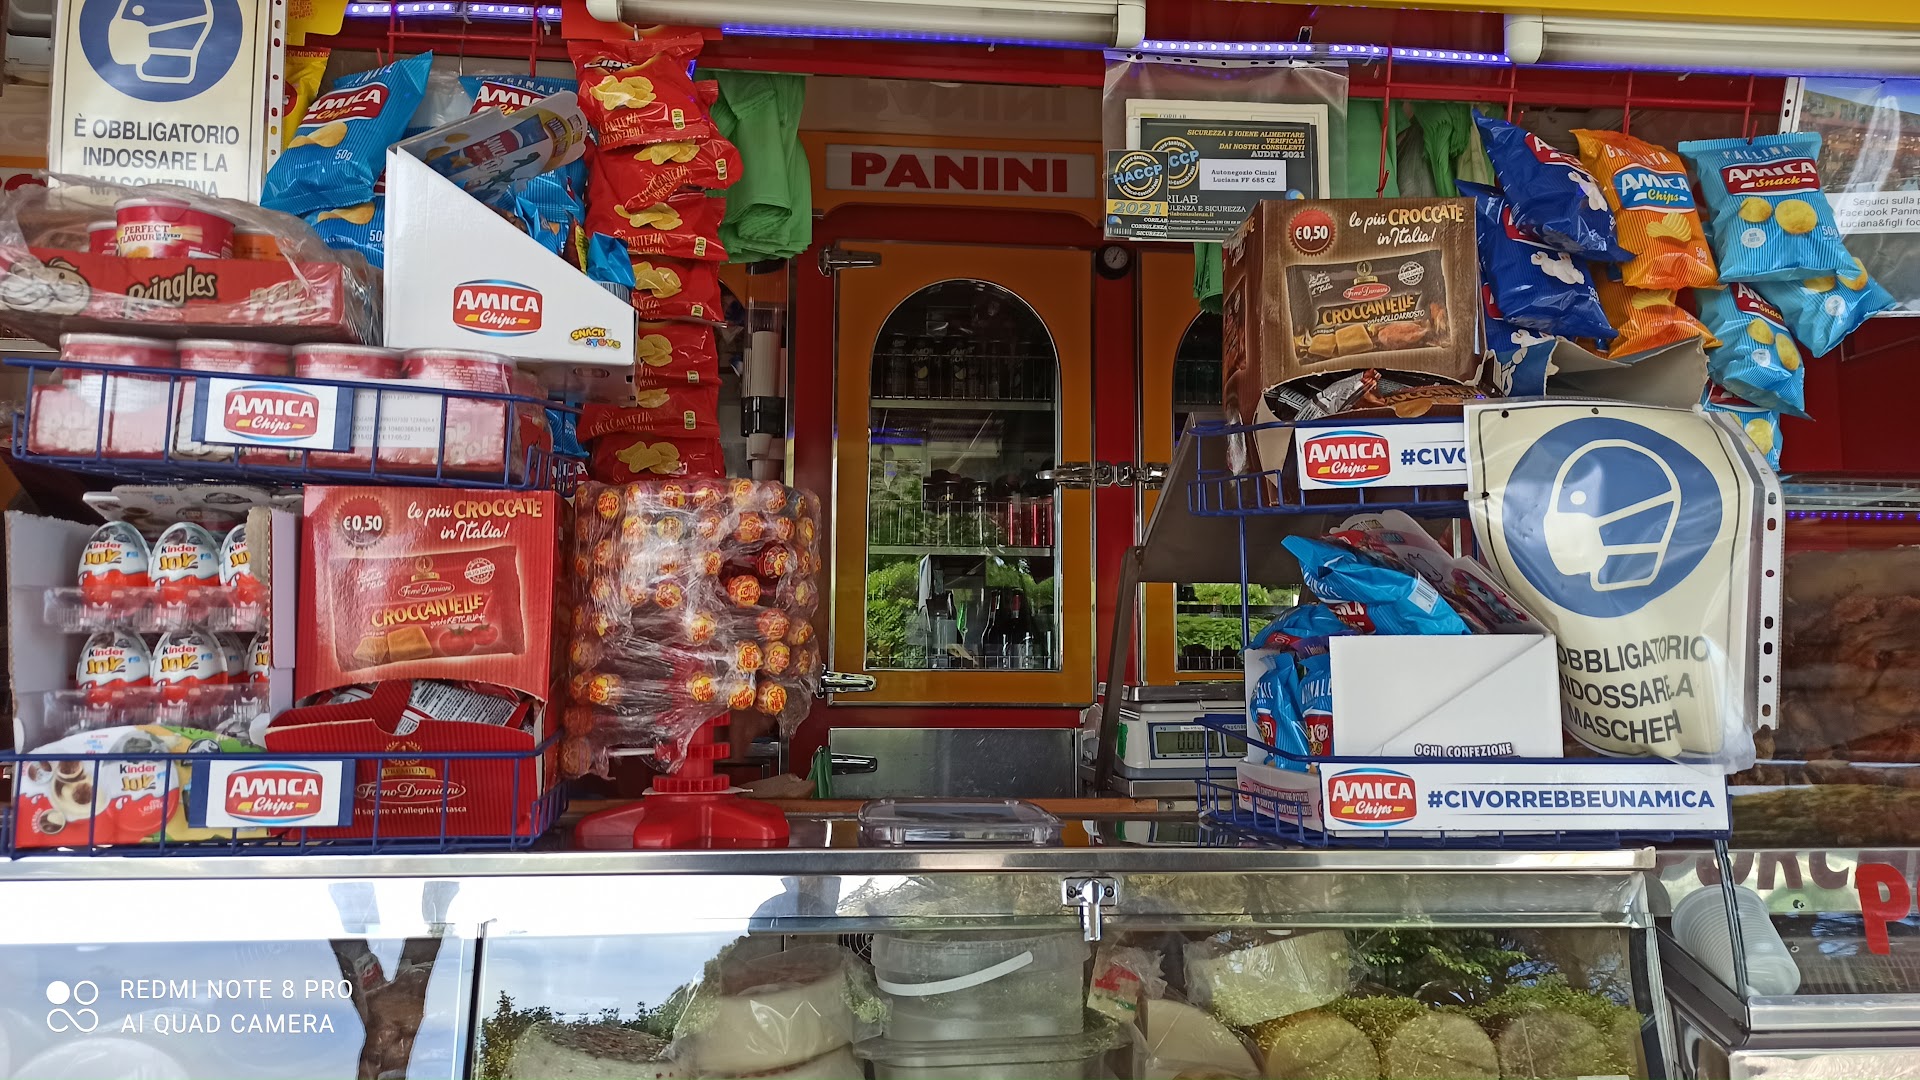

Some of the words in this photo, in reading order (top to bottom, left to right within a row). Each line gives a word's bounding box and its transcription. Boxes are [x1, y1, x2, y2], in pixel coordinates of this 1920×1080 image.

[475, 85, 544, 106] AMI
[74, 113, 86, 137] È
[93, 119, 240, 145] OBBLIGATORIO
[82, 147, 197, 171] INDOSSARE
[204, 153, 228, 173] LA
[335, 149, 353, 160] 50g
[1169, 150, 1199, 167] CCP
[1723, 146, 1791, 161] PALLINA
[851, 152, 1067, 192] PANINI
[1113, 164, 1163, 184] HACCP
[1728, 162, 1816, 183] AMICA
[1622, 173, 1691, 196] AMICA
[1756, 176, 1801, 188] Snack
[1167, 194, 1199, 204] RILAB
[1648, 189, 1679, 204] Chips
[1853, 197, 1889, 207] Seguici
[1891, 197, 1915, 205] sulla
[1113, 201, 1162, 216] 2021
[1168, 204, 1196, 212] ULENZA
[1349, 213, 1362, 227] le
[1388, 204, 1464, 227] CROCCATE
[1840, 208, 1888, 217] Facebook
[124, 224, 170, 235] PERFECT
[369, 229, 385, 242] 50
[1295, 225, 1328, 241] €0,50
[1378, 231, 1391, 245] in
[1390, 225, 1437, 247] Italia!
[1822, 225, 1838, 238] 50g
[119, 233, 155, 245] FLAVOUR
[456, 290, 539, 313] AMICA
[1322, 294, 1416, 326] CROCCANTELLE
[479, 311, 518, 327] Chips
[570, 328, 606, 341] SNACK
[228, 395, 315, 418] AMICA
[251, 415, 291, 432] Chips
[1308, 443, 1386, 463] AMICA
[1401, 447, 1466, 465] #CIVO
[1331, 462, 1367, 476] Chips
[407, 502, 423, 519] le
[453, 498, 543, 520] CROCCATE
[343, 515, 383, 532] €0,50
[440, 525, 457, 540] in
[456, 520, 510, 542] Italia!
[87, 541, 122, 550] Kinder
[161, 545, 197, 554] Kinder
[229, 543, 247, 553] Kin
[84, 549, 122, 566] JOY
[159, 553, 197, 571] JOY
[231, 551, 250, 568] JO
[371, 593, 484, 628] CROCCANTELLE
[88, 649, 124, 658] Kinder
[162, 645, 197, 655] Kinder
[257, 643, 269, 652] Kin
[1557, 635, 1710, 673] OBBLIGATORIO
[86, 657, 125, 675] JOY
[160, 654, 198, 673] JOY
[256, 653, 269, 666] JO
[1559, 670, 1673, 709] NDOSSARE
[1669, 672, 1695, 699] A
[1415, 744, 1442, 757] OGNI
[1446, 742, 1513, 758] CONFEZIONE
[119, 763, 156, 774] Kinder
[384, 767, 428, 776] PREMIUM
[121, 774, 157, 791] JOY
[229, 776, 319, 797] AMICA
[1332, 780, 1413, 800] AMICA
[253, 796, 294, 812] Chips
[1355, 799, 1393, 815] Chips
[1428, 789, 1715, 809] #CIVORREBBEUNAMICA
[398, 806, 434, 816] l'allegria
[445, 805, 467, 814] tasca
